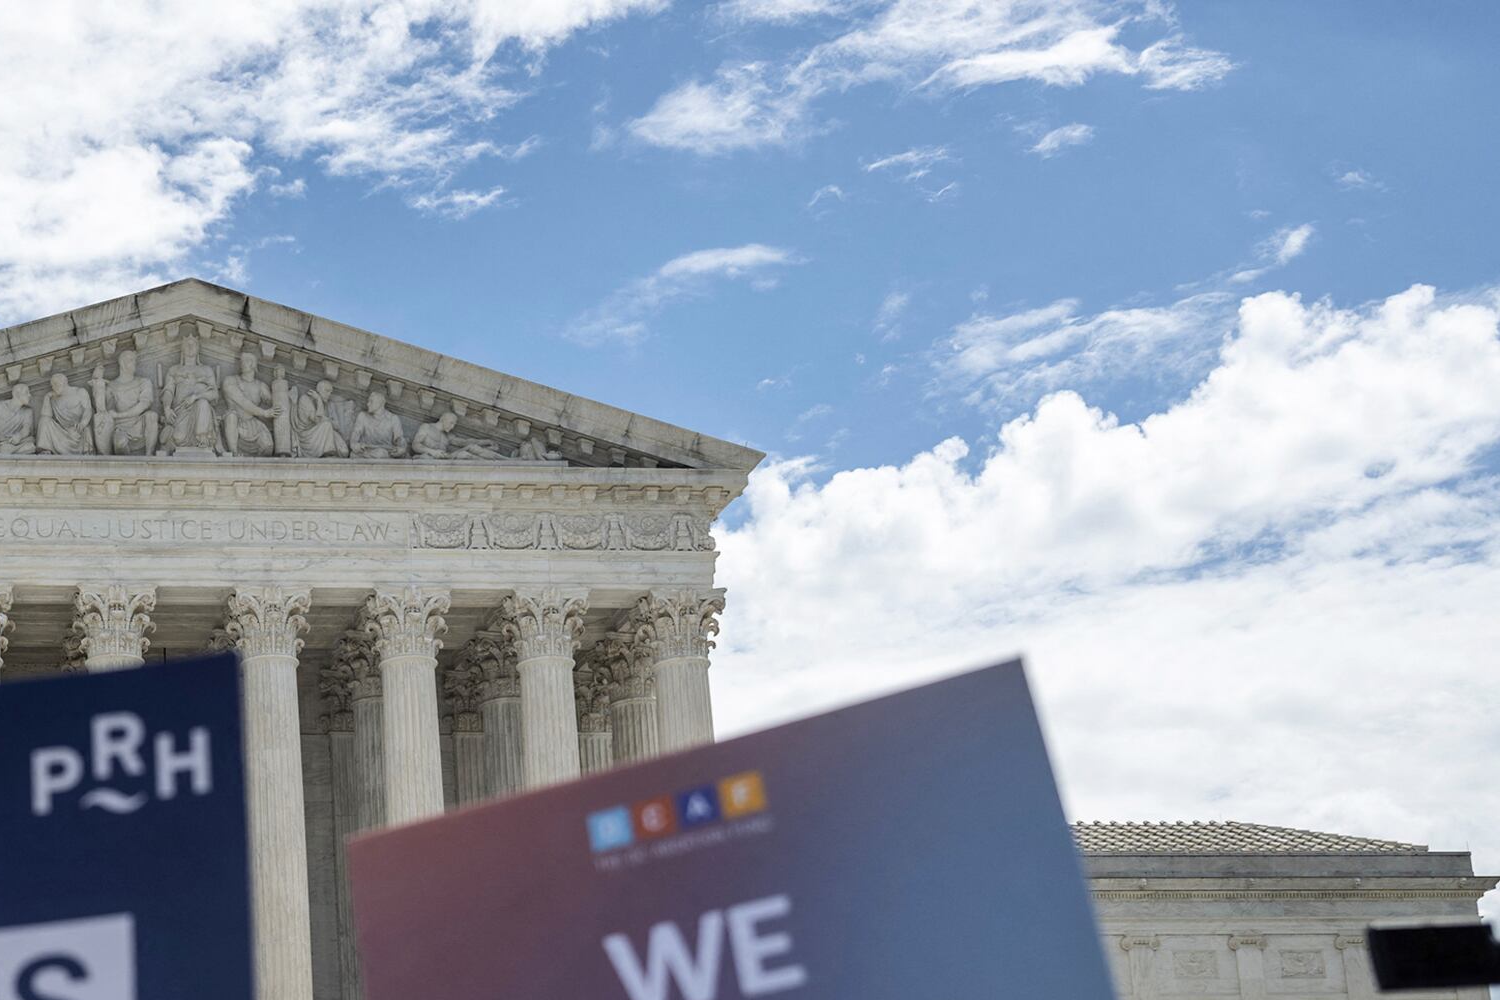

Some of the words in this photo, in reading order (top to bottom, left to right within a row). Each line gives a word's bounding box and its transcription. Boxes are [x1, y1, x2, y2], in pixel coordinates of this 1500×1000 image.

[99, 518, 213, 541] JUSTICE
[228, 519, 323, 541] UNDER
[336, 521, 390, 542] LAW
[30, 711, 212, 816] PRH
